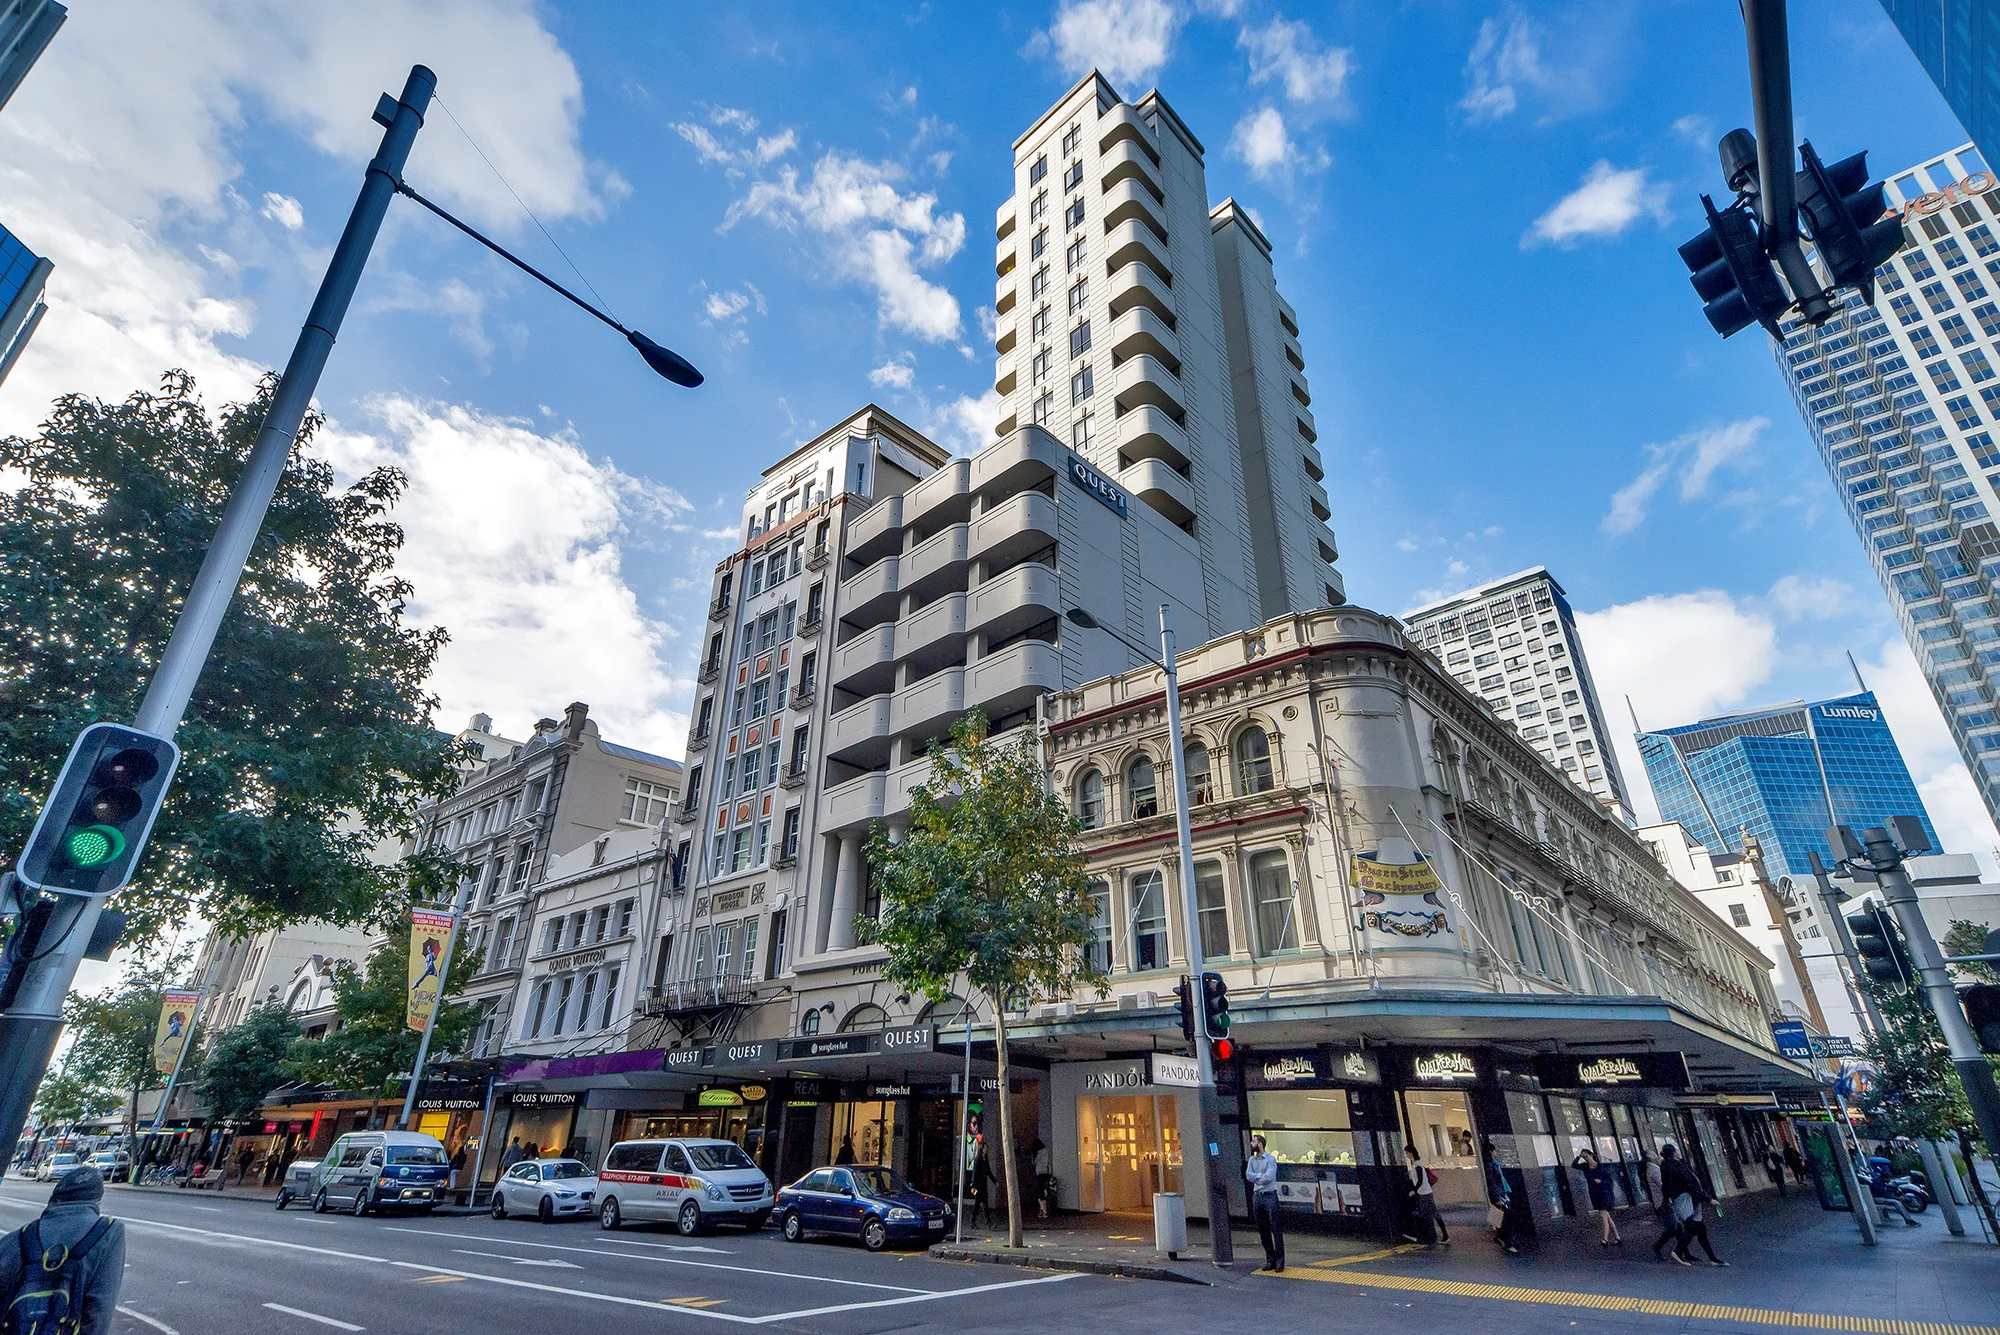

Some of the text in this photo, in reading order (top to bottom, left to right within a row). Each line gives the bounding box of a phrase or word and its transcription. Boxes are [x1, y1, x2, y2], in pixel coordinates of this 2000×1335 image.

[1074, 463, 1126, 509] QUEST
[1820, 705, 1877, 722] Lumley
[718, 891, 745, 903] WINDSOR
[720, 900, 740, 910] HOUSE
[549, 949, 607, 972] LOUIS VUITTON
[885, 1029, 929, 1048] QUEST
[728, 1045, 762, 1061] QUEST
[818, 1041, 848, 1053] sunglass hut
[1783, 1047, 1809, 1056] TAB
[668, 1050, 699, 1066] QUEST
[980, 1079, 1002, 1091] QUES
[1086, 1068, 1150, 1089] PANDOR
[794, 1081, 820, 1095] REAL
[875, 1085, 900, 1097] sunglass
[900, 1085, 911, 1096] hut
[418, 1099, 480, 1109] LOUIS VUITTON
[512, 1093, 576, 1103] LOUIS VUITTON
